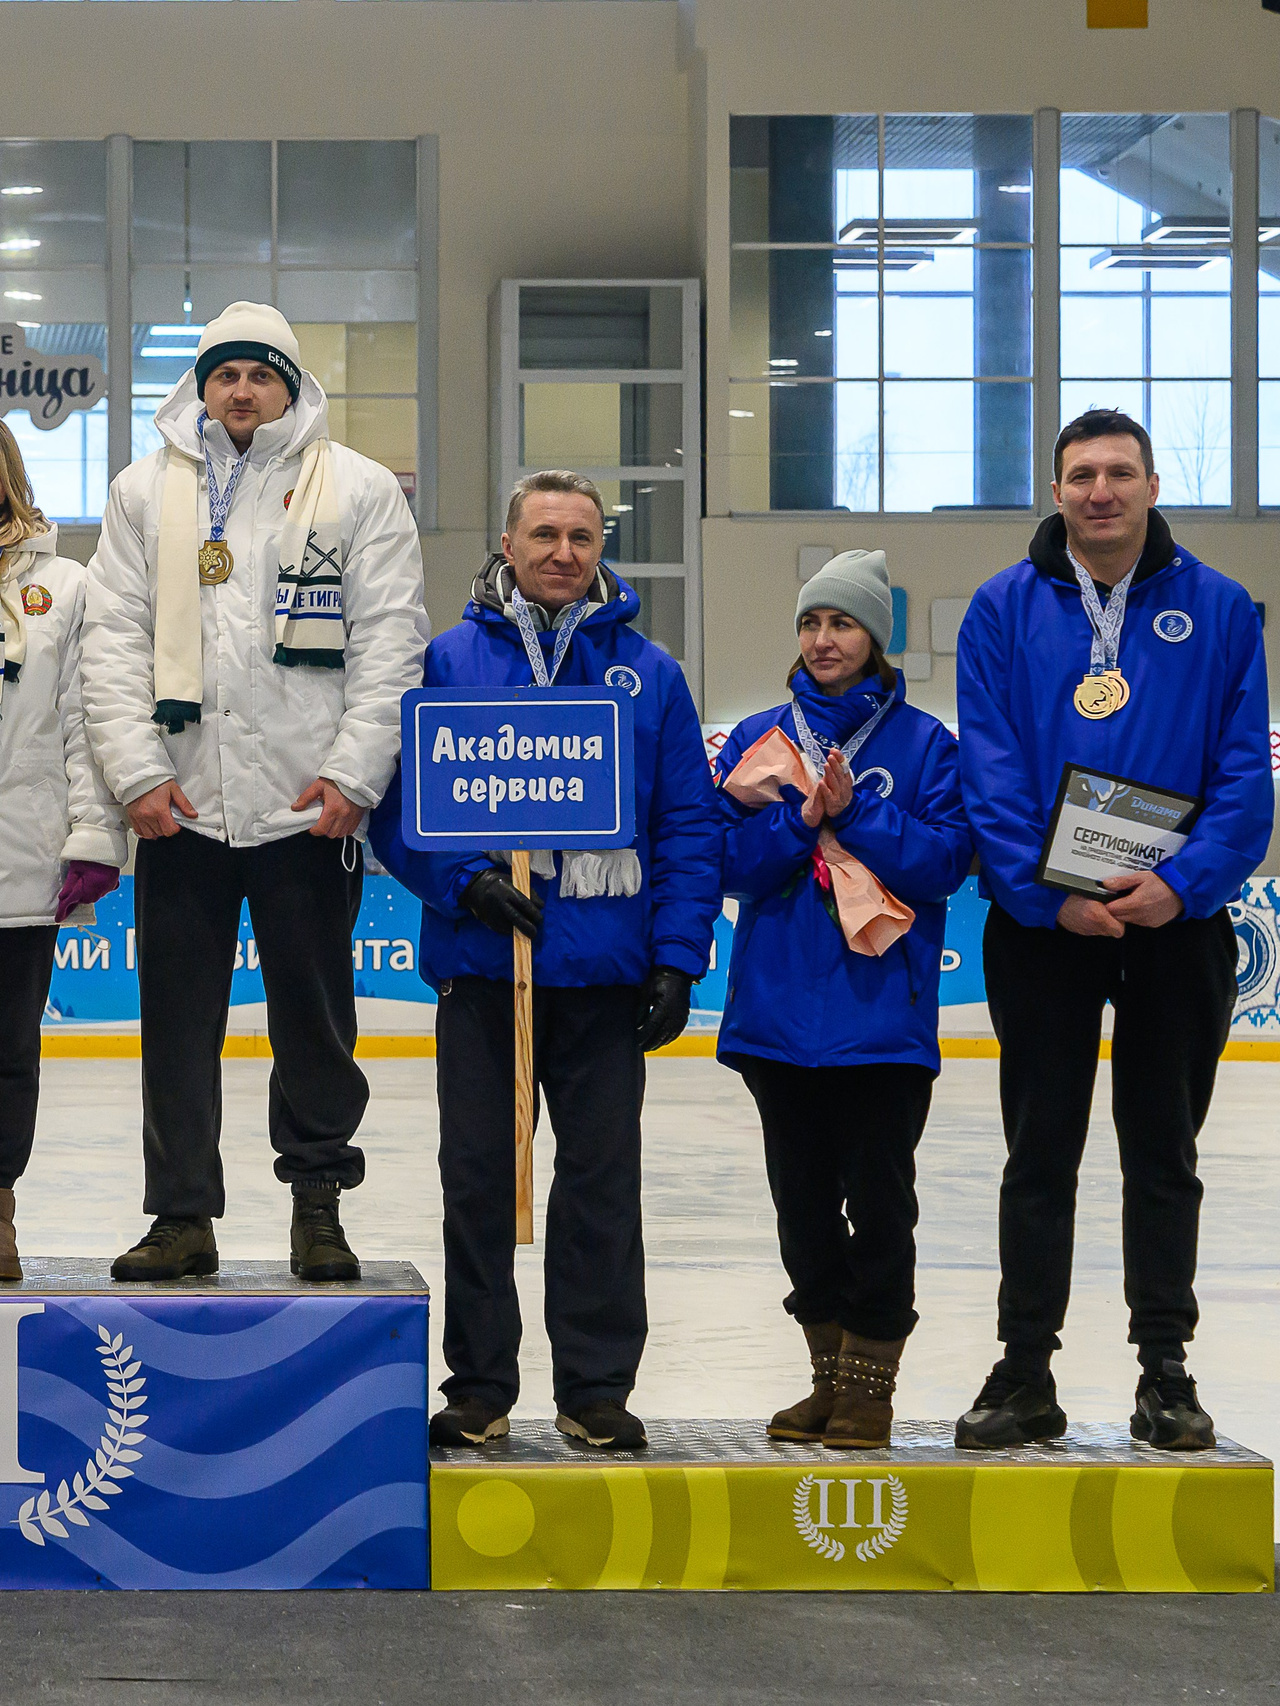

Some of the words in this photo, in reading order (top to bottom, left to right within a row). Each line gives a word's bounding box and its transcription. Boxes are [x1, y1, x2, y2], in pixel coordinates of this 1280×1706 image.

[432, 724, 603, 764] Академия
[452, 774, 584, 814] сервиса
[1073, 826, 1166, 862] СЕРТИФИКАТ
